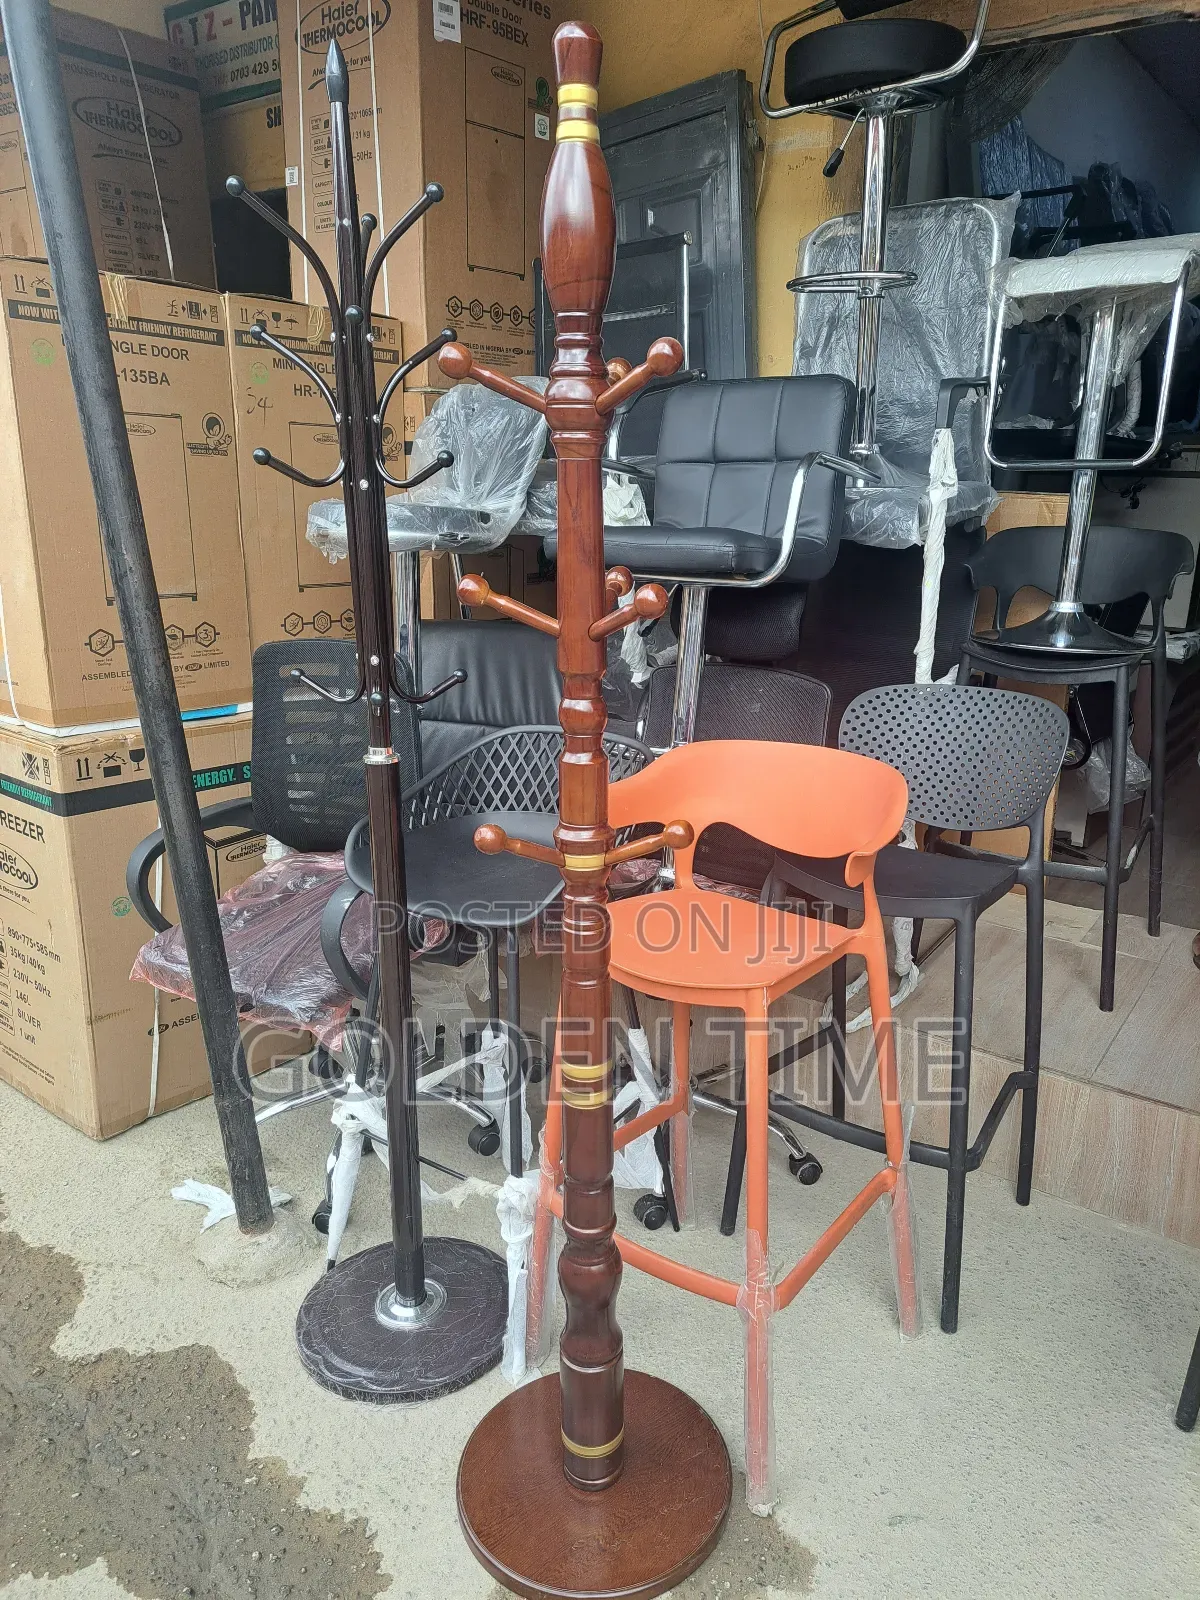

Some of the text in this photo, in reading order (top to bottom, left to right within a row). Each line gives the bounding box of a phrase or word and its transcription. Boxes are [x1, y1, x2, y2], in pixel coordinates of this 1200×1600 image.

[321, 0, 359, 25] Haier
[502, 7, 523, 25] Door
[303, 10, 383, 48] THERMOCOOL
[229, 36, 273, 62] DISTRIBUTOR
[230, 65, 250, 82] 0703
[252, 61, 269, 76] 429
[138, 253, 160, 262] SILVER
[18, 304, 39, 317] NOW
[42, 308, 59, 321] WIT
[139, 322, 171, 336] FRIENDLY
[173, 327, 218, 342] REFRIGERANT
[152, 345, 189, 361] DOOR
[203, 660, 230, 669] LIMITED
[240, 842, 261, 852] Haier
[17, 1007, 42, 1031] SILVER
[171, 1013, 199, 1029] ASSE
